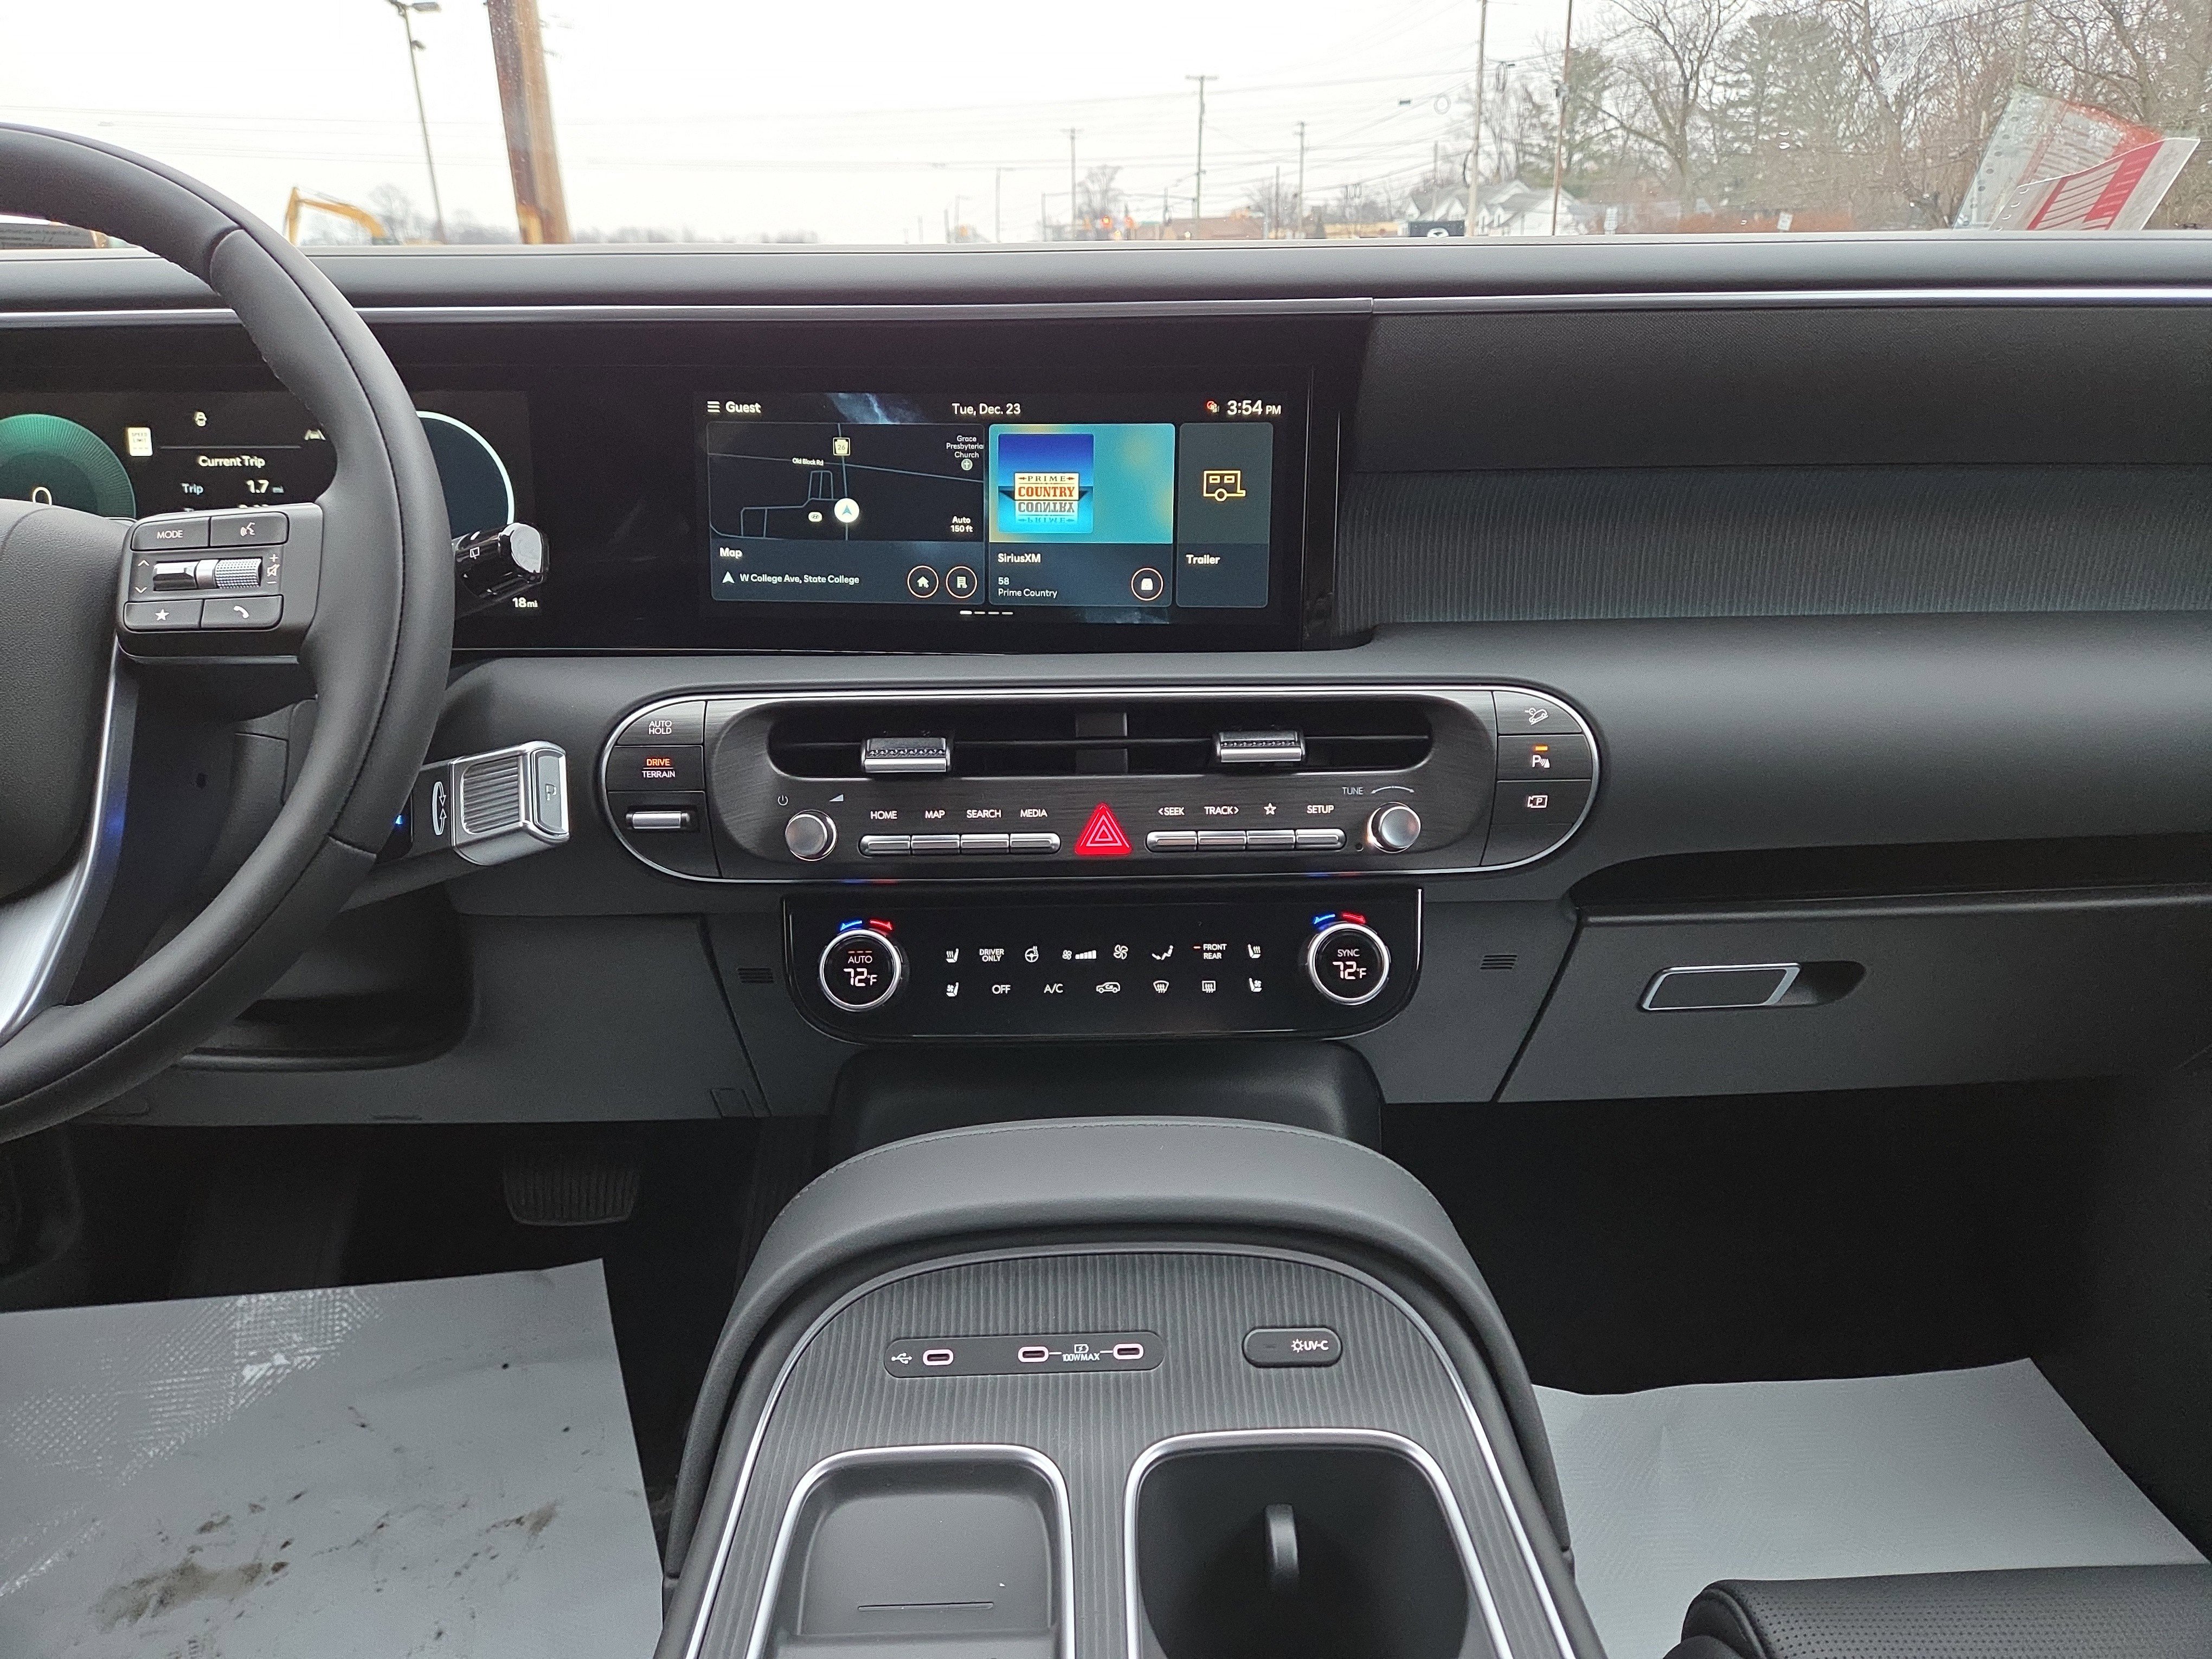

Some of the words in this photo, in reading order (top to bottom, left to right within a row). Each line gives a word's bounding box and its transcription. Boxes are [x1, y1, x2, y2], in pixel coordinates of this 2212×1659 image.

[725, 401, 761, 414] Guest
[951, 403, 976, 416] Tue,
[979, 403, 1003, 414] Dec.
[1006, 403, 1021, 414] 23
[1227, 400, 1263, 415] 3:54
[1265, 405, 1282, 415] PM
[198, 456, 242, 467] Current
[242, 455, 266, 468] Trip
[181, 483, 204, 496] Trip
[246, 479, 269, 494] 1.7
[1018, 487, 1075, 497] COUNTRY
[157, 529, 184, 539] MODE
[967, 525, 973, 533] ft
[719, 548, 743, 559] Map
[998, 554, 1041, 563] SiriusXM
[1186, 555, 1220, 564] Trailer
[740, 574, 749, 583] W
[750, 574, 782, 586] College
[783, 574, 802, 584] Ave,
[803, 575, 827, 584] State
[828, 575, 860, 586] College
[998, 577, 1009, 586] 58
[998, 588, 1022, 597] Prime
[1024, 588, 1058, 599] Country
[646, 758, 671, 767] DRIVE
[642, 770, 676, 779] TERRAIN
[1342, 787, 1364, 796] TUNE
[925, 809, 945, 819] MAP
[967, 809, 1002, 819] SEARCH
[1020, 808, 1048, 818] MEDIA
[1307, 805, 1334, 814] SETUP
[870, 810, 898, 820] HOME
[1337, 949, 1360, 957] SYNC
[847, 955, 872, 964] AUTO
[992, 985, 1011, 994] OFF
[1044, 983, 1064, 994] A/C
[1304, 1340, 1329, 1351] UV-C
